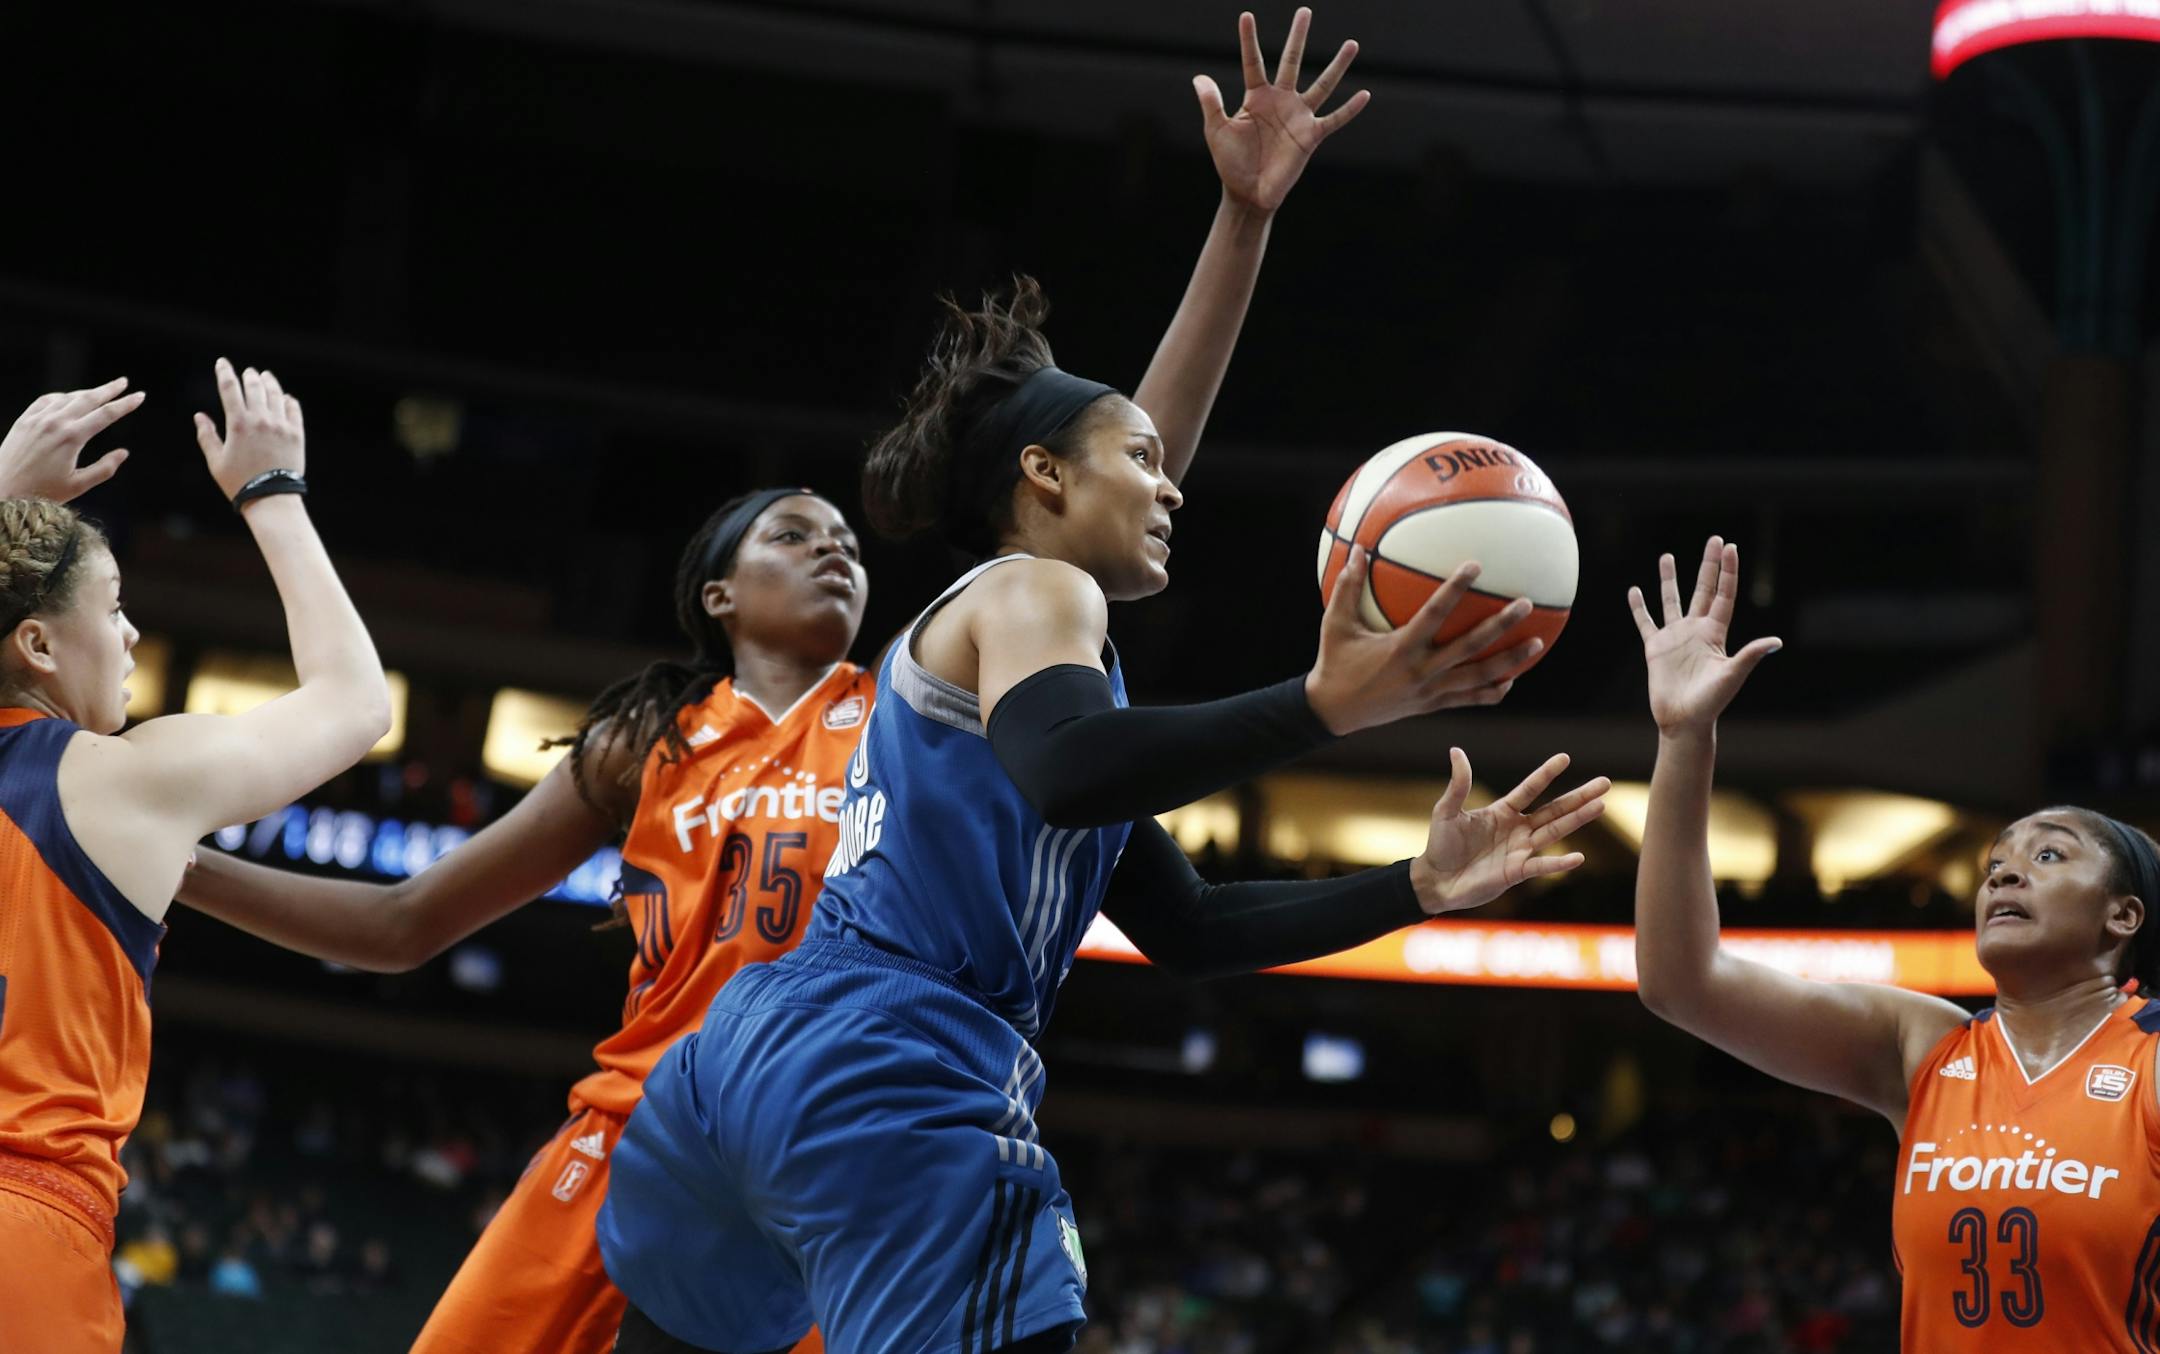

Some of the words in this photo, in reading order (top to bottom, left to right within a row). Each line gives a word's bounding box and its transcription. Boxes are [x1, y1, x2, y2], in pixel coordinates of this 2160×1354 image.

[672, 773, 848, 853] Frontie
[714, 832, 808, 945] 35
[1904, 1142, 2119, 1199] Frontier
[1948, 1206, 2044, 1328] 33
